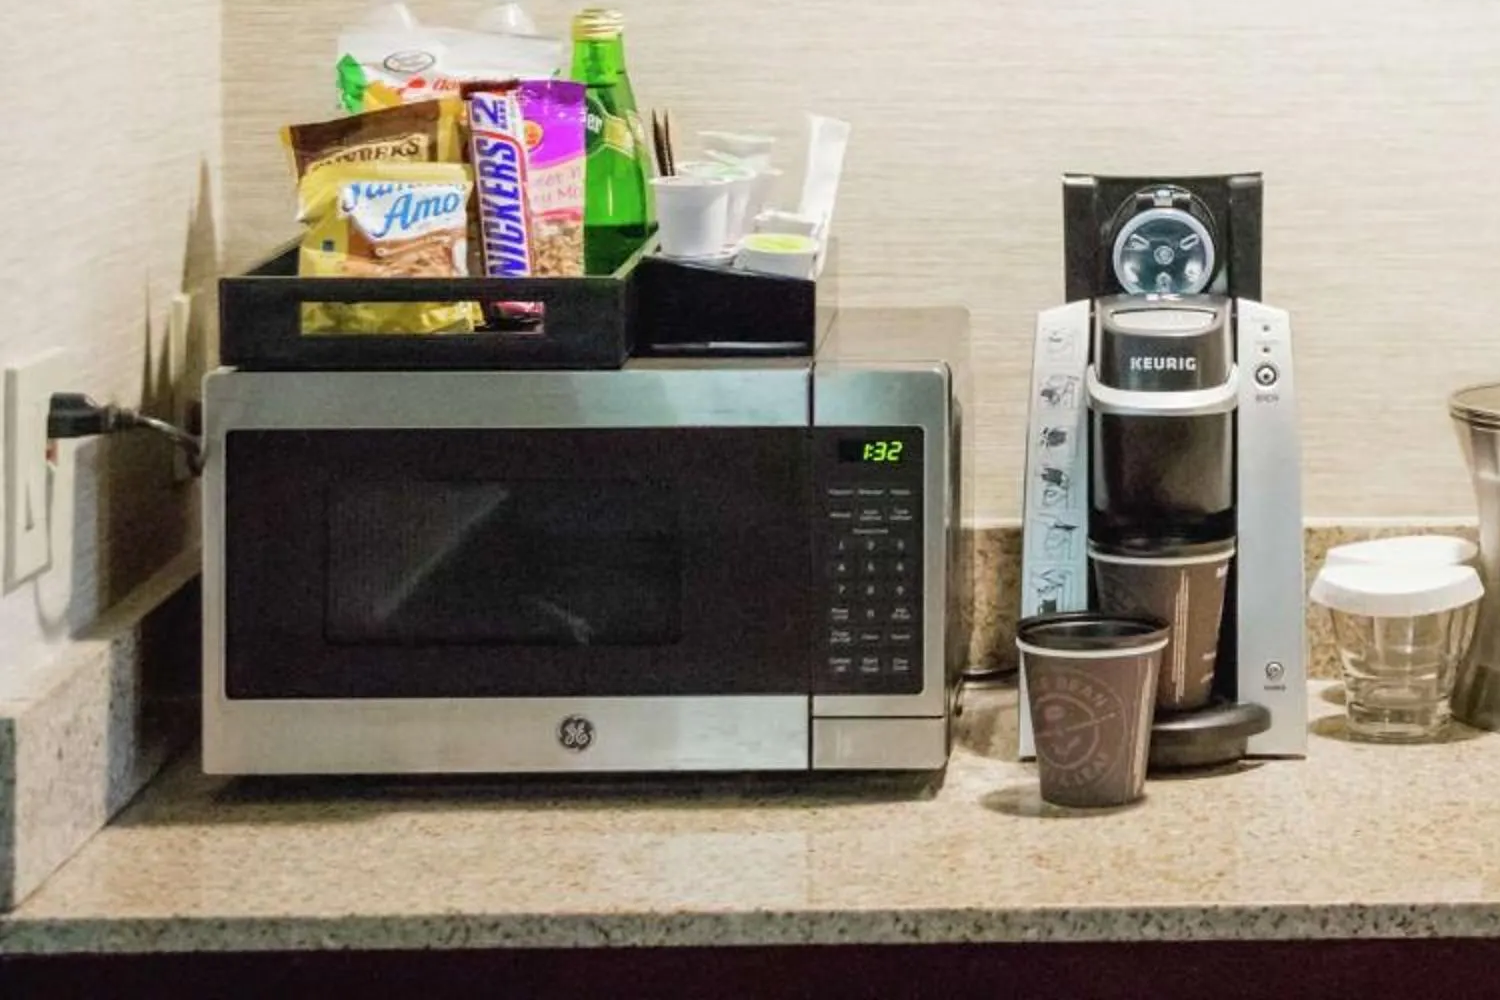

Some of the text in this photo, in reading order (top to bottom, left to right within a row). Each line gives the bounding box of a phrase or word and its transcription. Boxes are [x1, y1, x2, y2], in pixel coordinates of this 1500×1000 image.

[371, 191, 460, 238] Amo
[475, 137, 527, 277] NICKERS
[1130, 356, 1197, 371] KEURIG
[863, 441, 903, 461] 1:32
